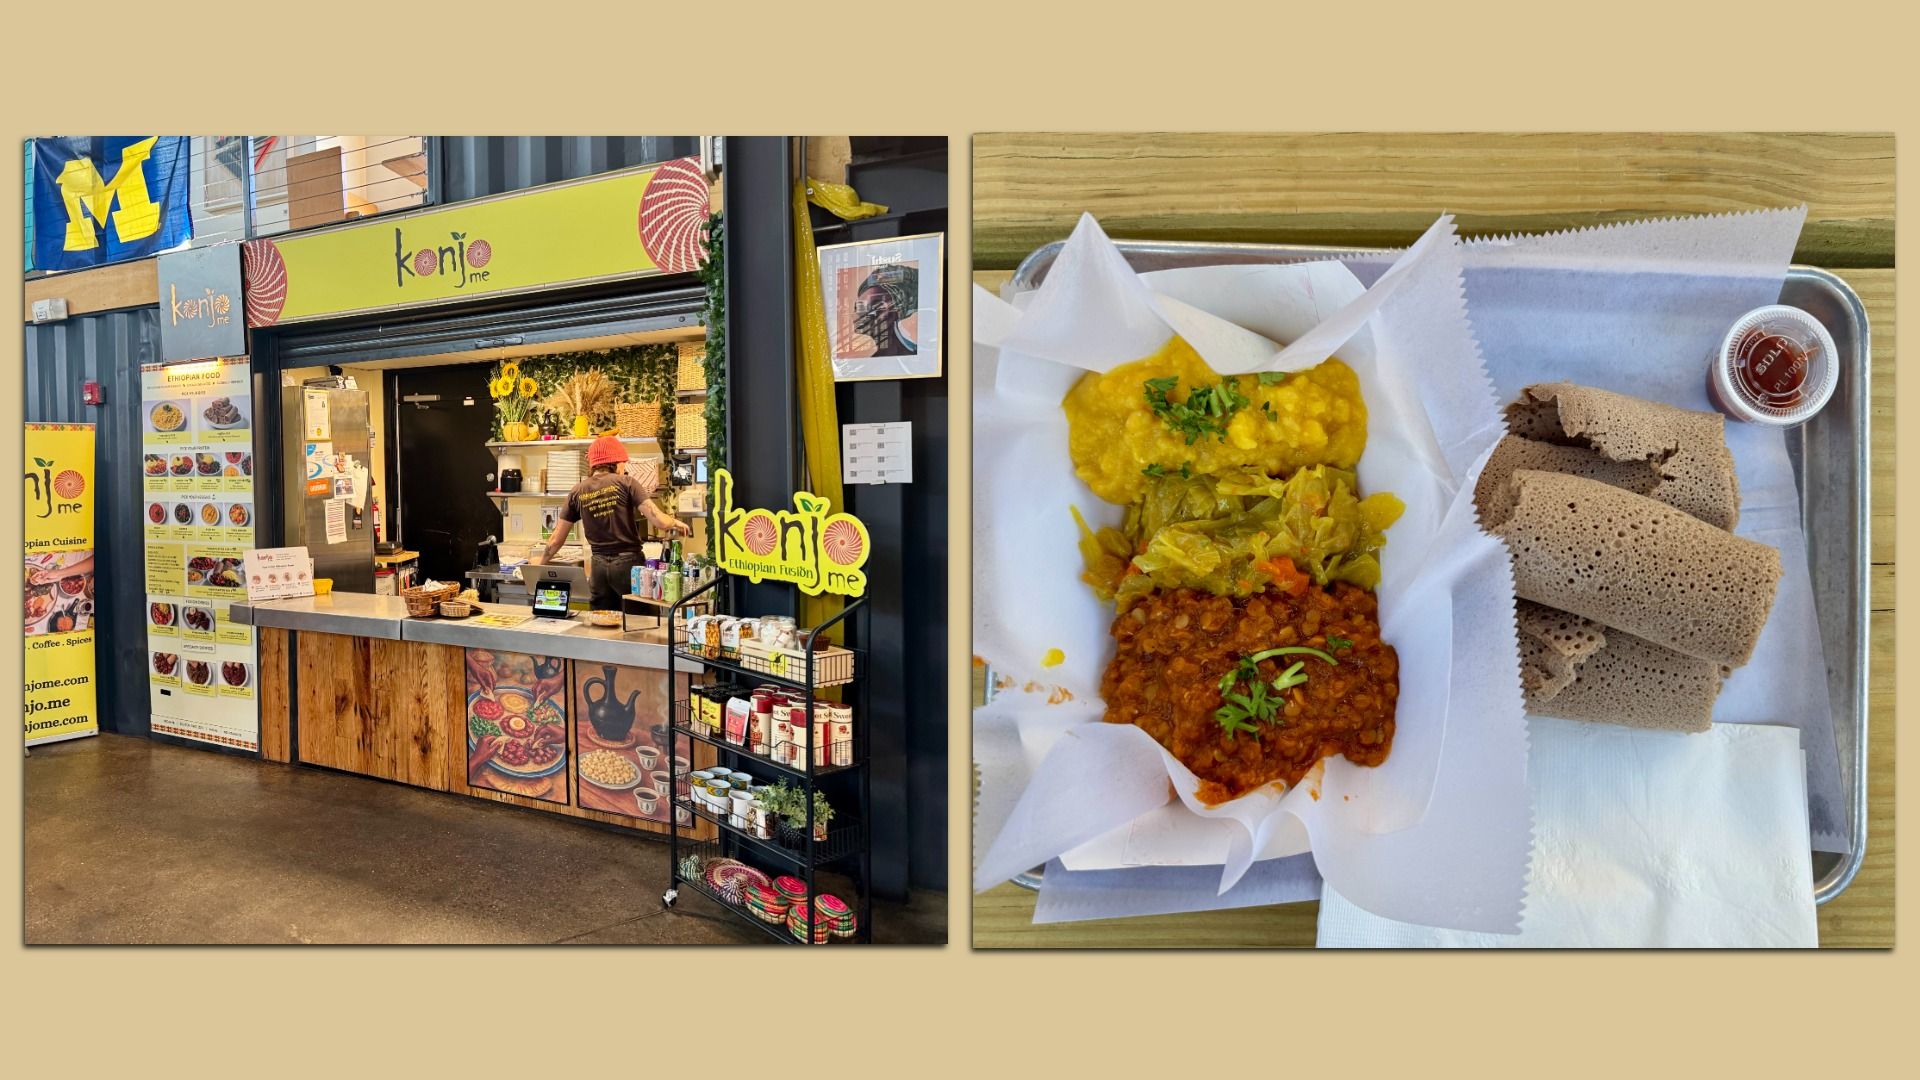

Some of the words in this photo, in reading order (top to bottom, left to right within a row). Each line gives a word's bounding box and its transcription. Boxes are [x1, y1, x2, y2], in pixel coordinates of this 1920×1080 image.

[395, 228, 492, 289] konjo
[469, 270, 490, 283] me
[170, 283, 230, 328] konjo
[216, 316, 231, 326] me
[1756, 337, 1788, 376] SOLO
[57, 503, 83, 515] me
[717, 474, 864, 589] konjo
[52, 537, 88, 546] Cuisine
[729, 558, 776, 577] Ethiopian
[828, 571, 860, 590] me
[32, 640, 61, 650] Coffee
[66, 636, 92, 647] Spices
